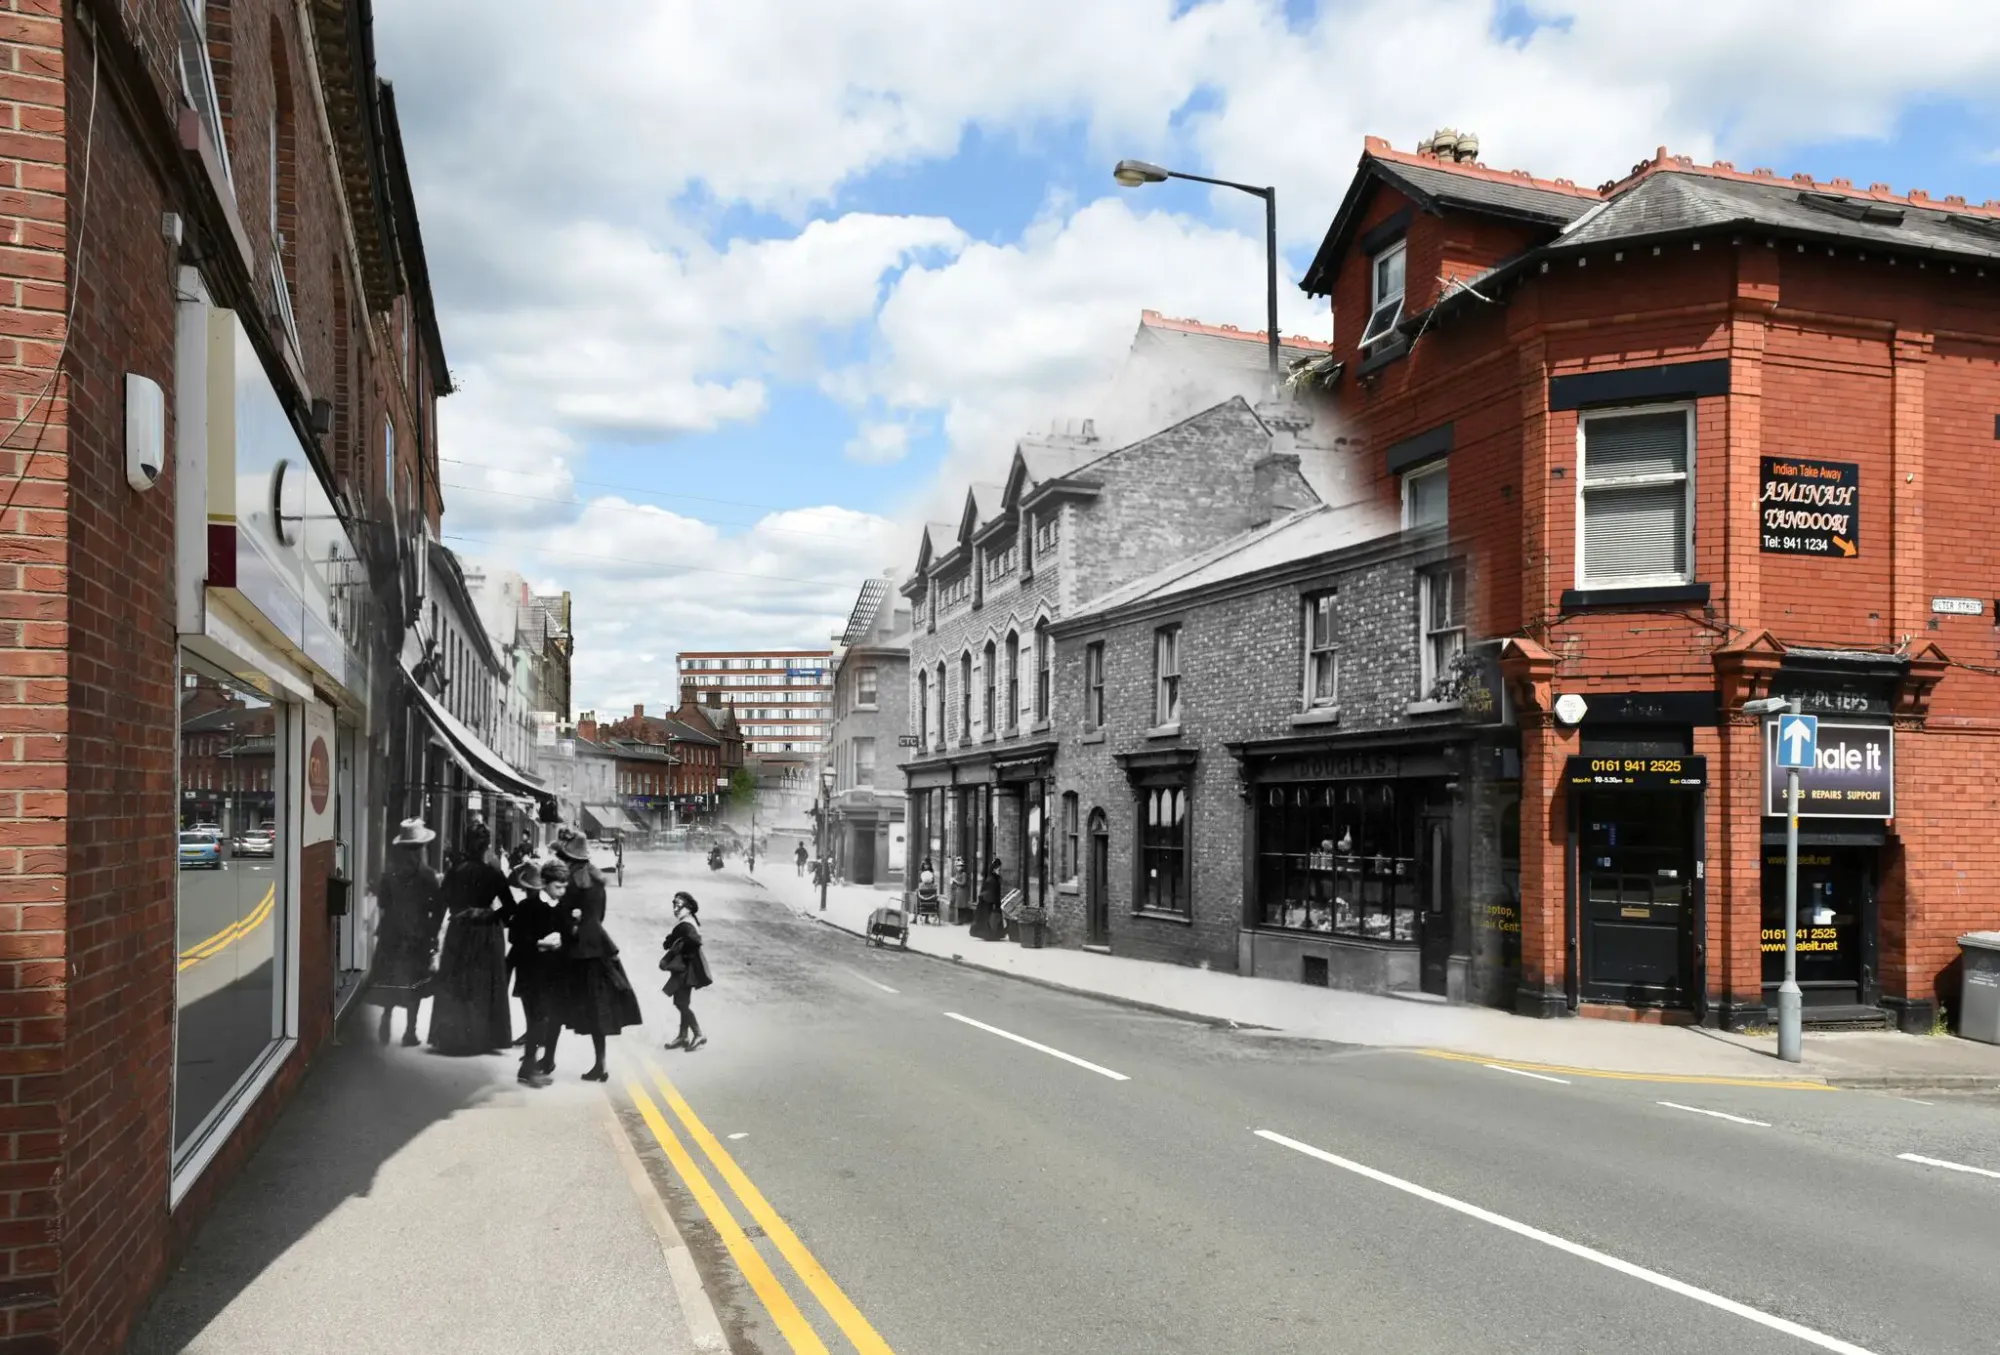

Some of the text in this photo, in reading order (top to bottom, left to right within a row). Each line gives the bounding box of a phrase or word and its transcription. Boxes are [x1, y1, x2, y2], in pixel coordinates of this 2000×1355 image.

[1773, 463, 1842, 482] Indian Take Away
[1760, 481, 1856, 506] AMINAH
[1764, 508, 1849, 535] TANDOORI
[1763, 535, 1828, 551] Tel: 941 1234
[899, 737, 917, 746] CTC
[1866, 743, 1881, 770] it
[1591, 760, 1681, 771] 0161 941 2525
[1782, 789, 1881, 801] SES REPAIRS SUPPORT
[1761, 928, 1837, 939] 0161 41 2525
